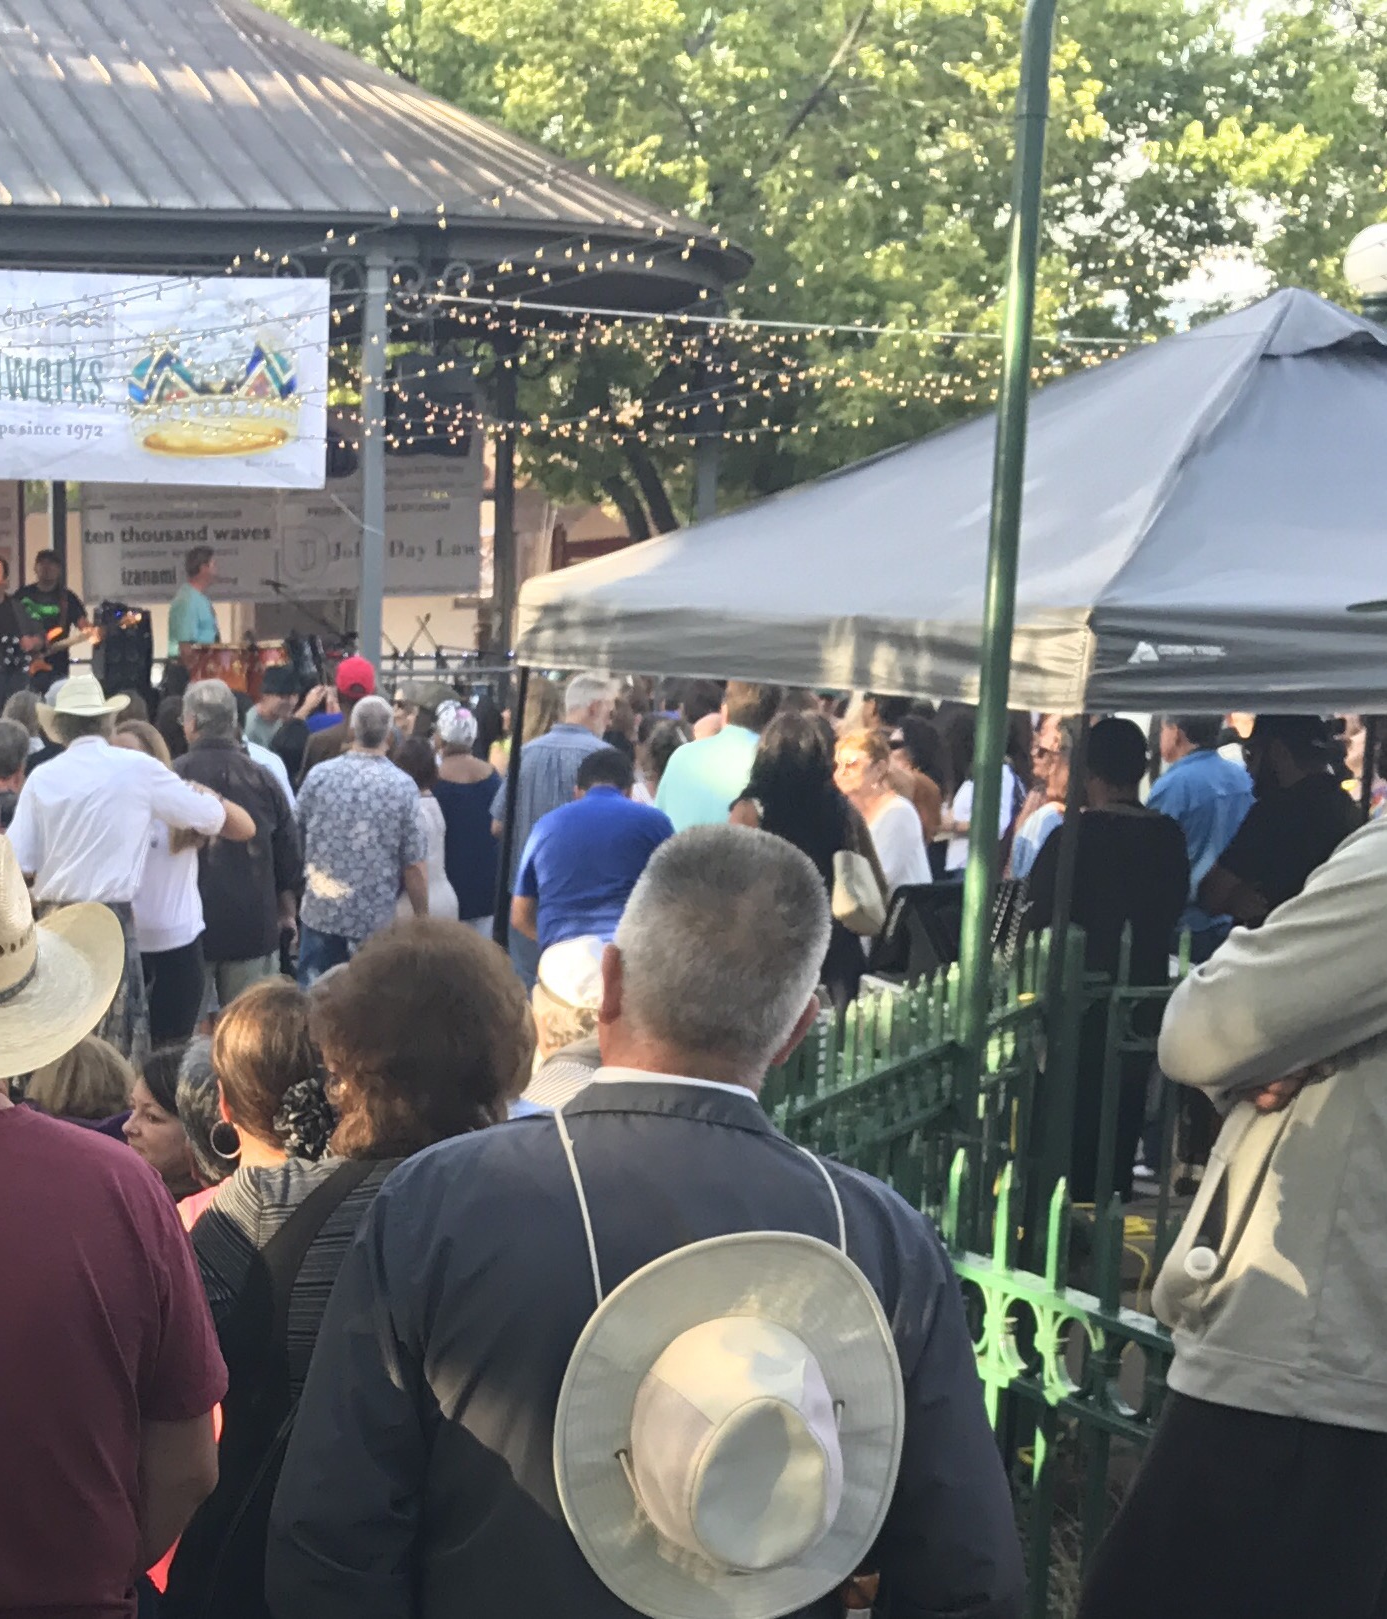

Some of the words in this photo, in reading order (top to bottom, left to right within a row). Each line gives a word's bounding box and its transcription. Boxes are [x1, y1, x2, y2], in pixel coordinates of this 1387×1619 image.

[19, 421, 62, 436] since
[66, 424, 104, 440] 1972
[84, 528, 115, 544] ten
[121, 525, 209, 544] thousand
[213, 526, 271, 541] waves
[389, 538, 426, 563] Day
